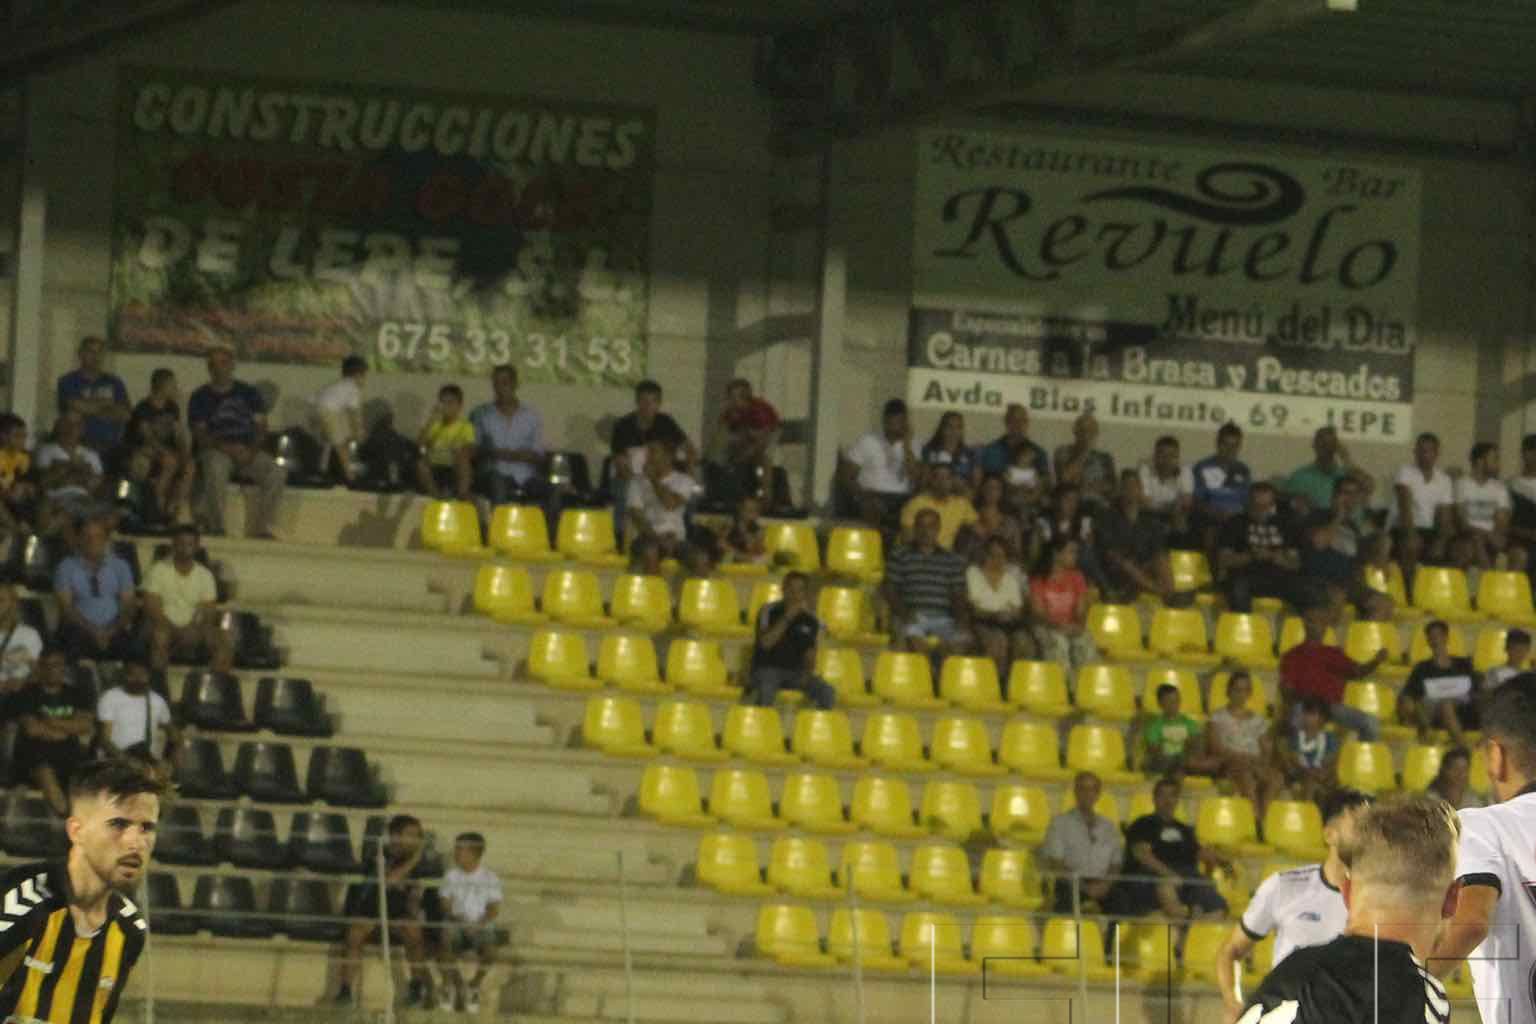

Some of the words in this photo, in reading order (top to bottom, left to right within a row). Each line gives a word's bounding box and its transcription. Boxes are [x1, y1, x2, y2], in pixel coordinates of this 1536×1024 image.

[132, 82, 645, 170] CONSTRUCCIONES
[932, 134, 1183, 182] Restaurante
[1322, 165, 1404, 200] Bar
[138, 214, 243, 275] DE
[932, 184, 1399, 291] Revuelo
[376, 321, 451, 362] 675
[464, 328, 511, 367] 33
[525, 332, 569, 371] 31
[586, 337, 633, 376] 53
[1277, 301, 1331, 343] del
[927, 332, 1041, 374] Carnes
[1122, 347, 1217, 389] Brasa
[1226, 364, 1248, 391] y
[1256, 356, 1401, 400] Pescados
[1248, 404, 1289, 427] 69
